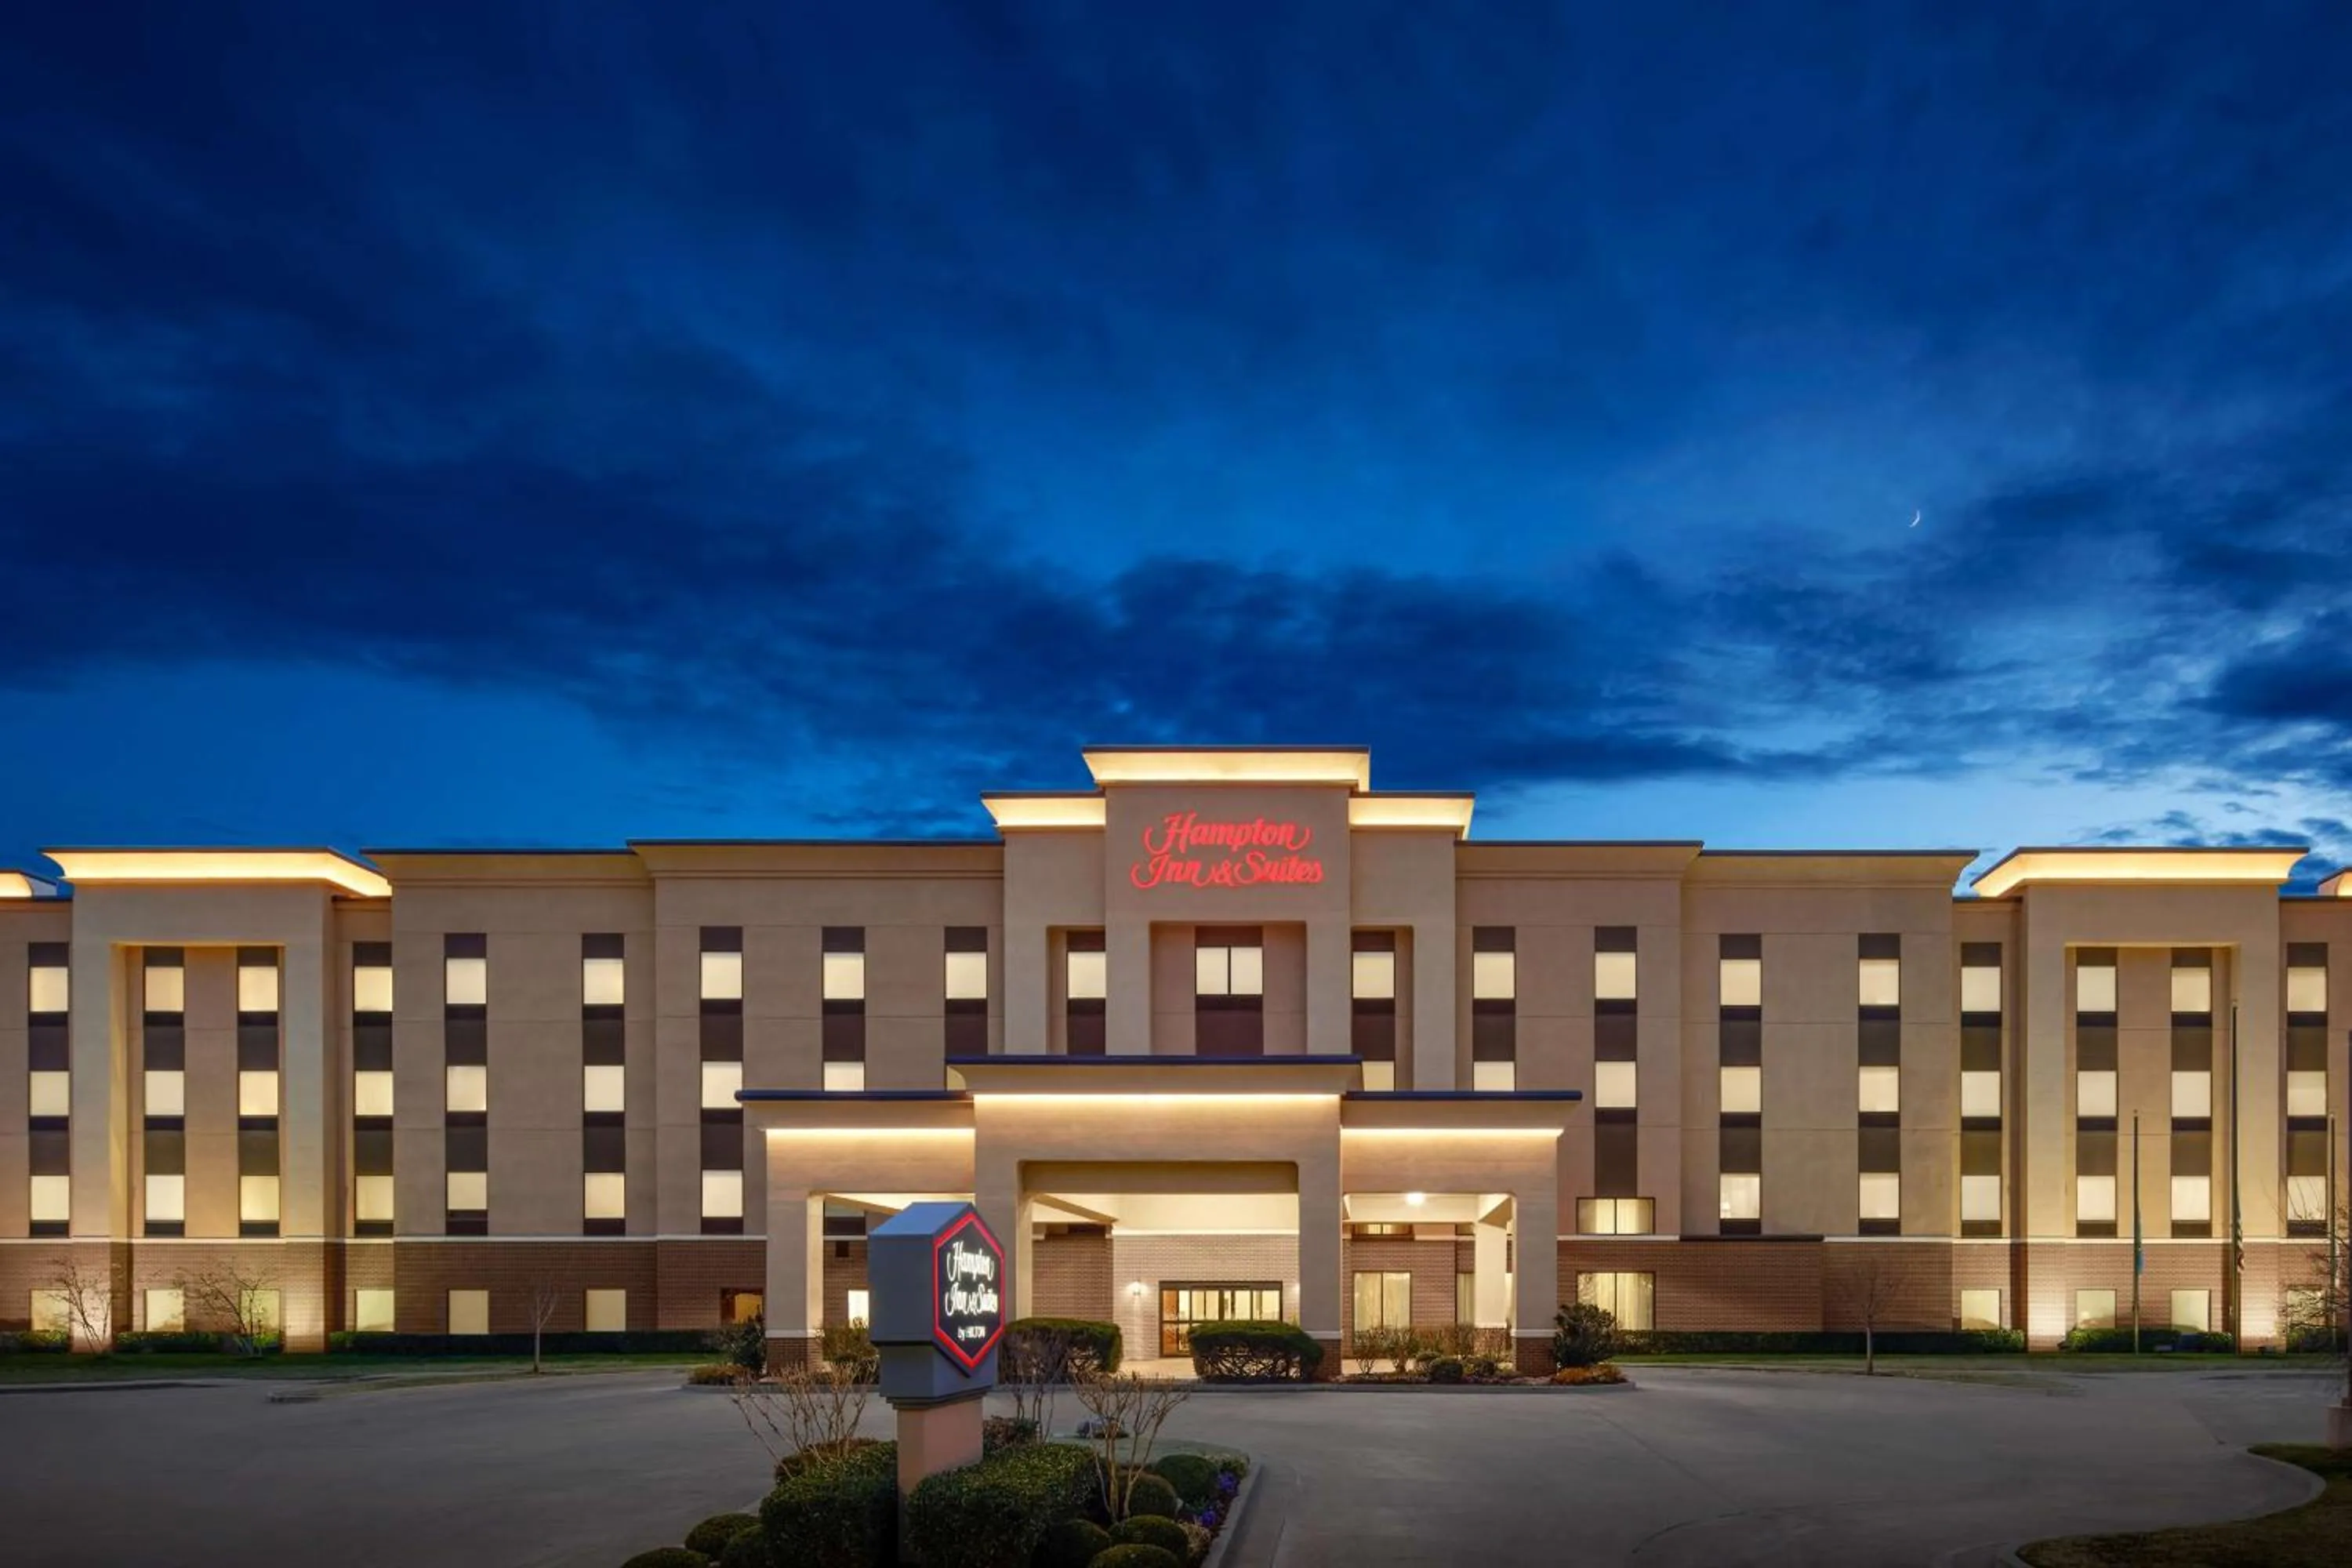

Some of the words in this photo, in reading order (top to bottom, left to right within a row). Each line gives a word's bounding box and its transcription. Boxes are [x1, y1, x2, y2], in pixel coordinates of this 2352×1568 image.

[1143, 811, 1311, 854] Hampton
[1131, 852, 1214, 887] Inn
[1214, 859, 1236, 887] &
[1233, 850, 1323, 886] Suites
[946, 1240, 994, 1281] Hampton
[945, 1282, 971, 1316] Inn
[976, 1283, 998, 1315] Suites
[957, 1327, 965, 1341] by
